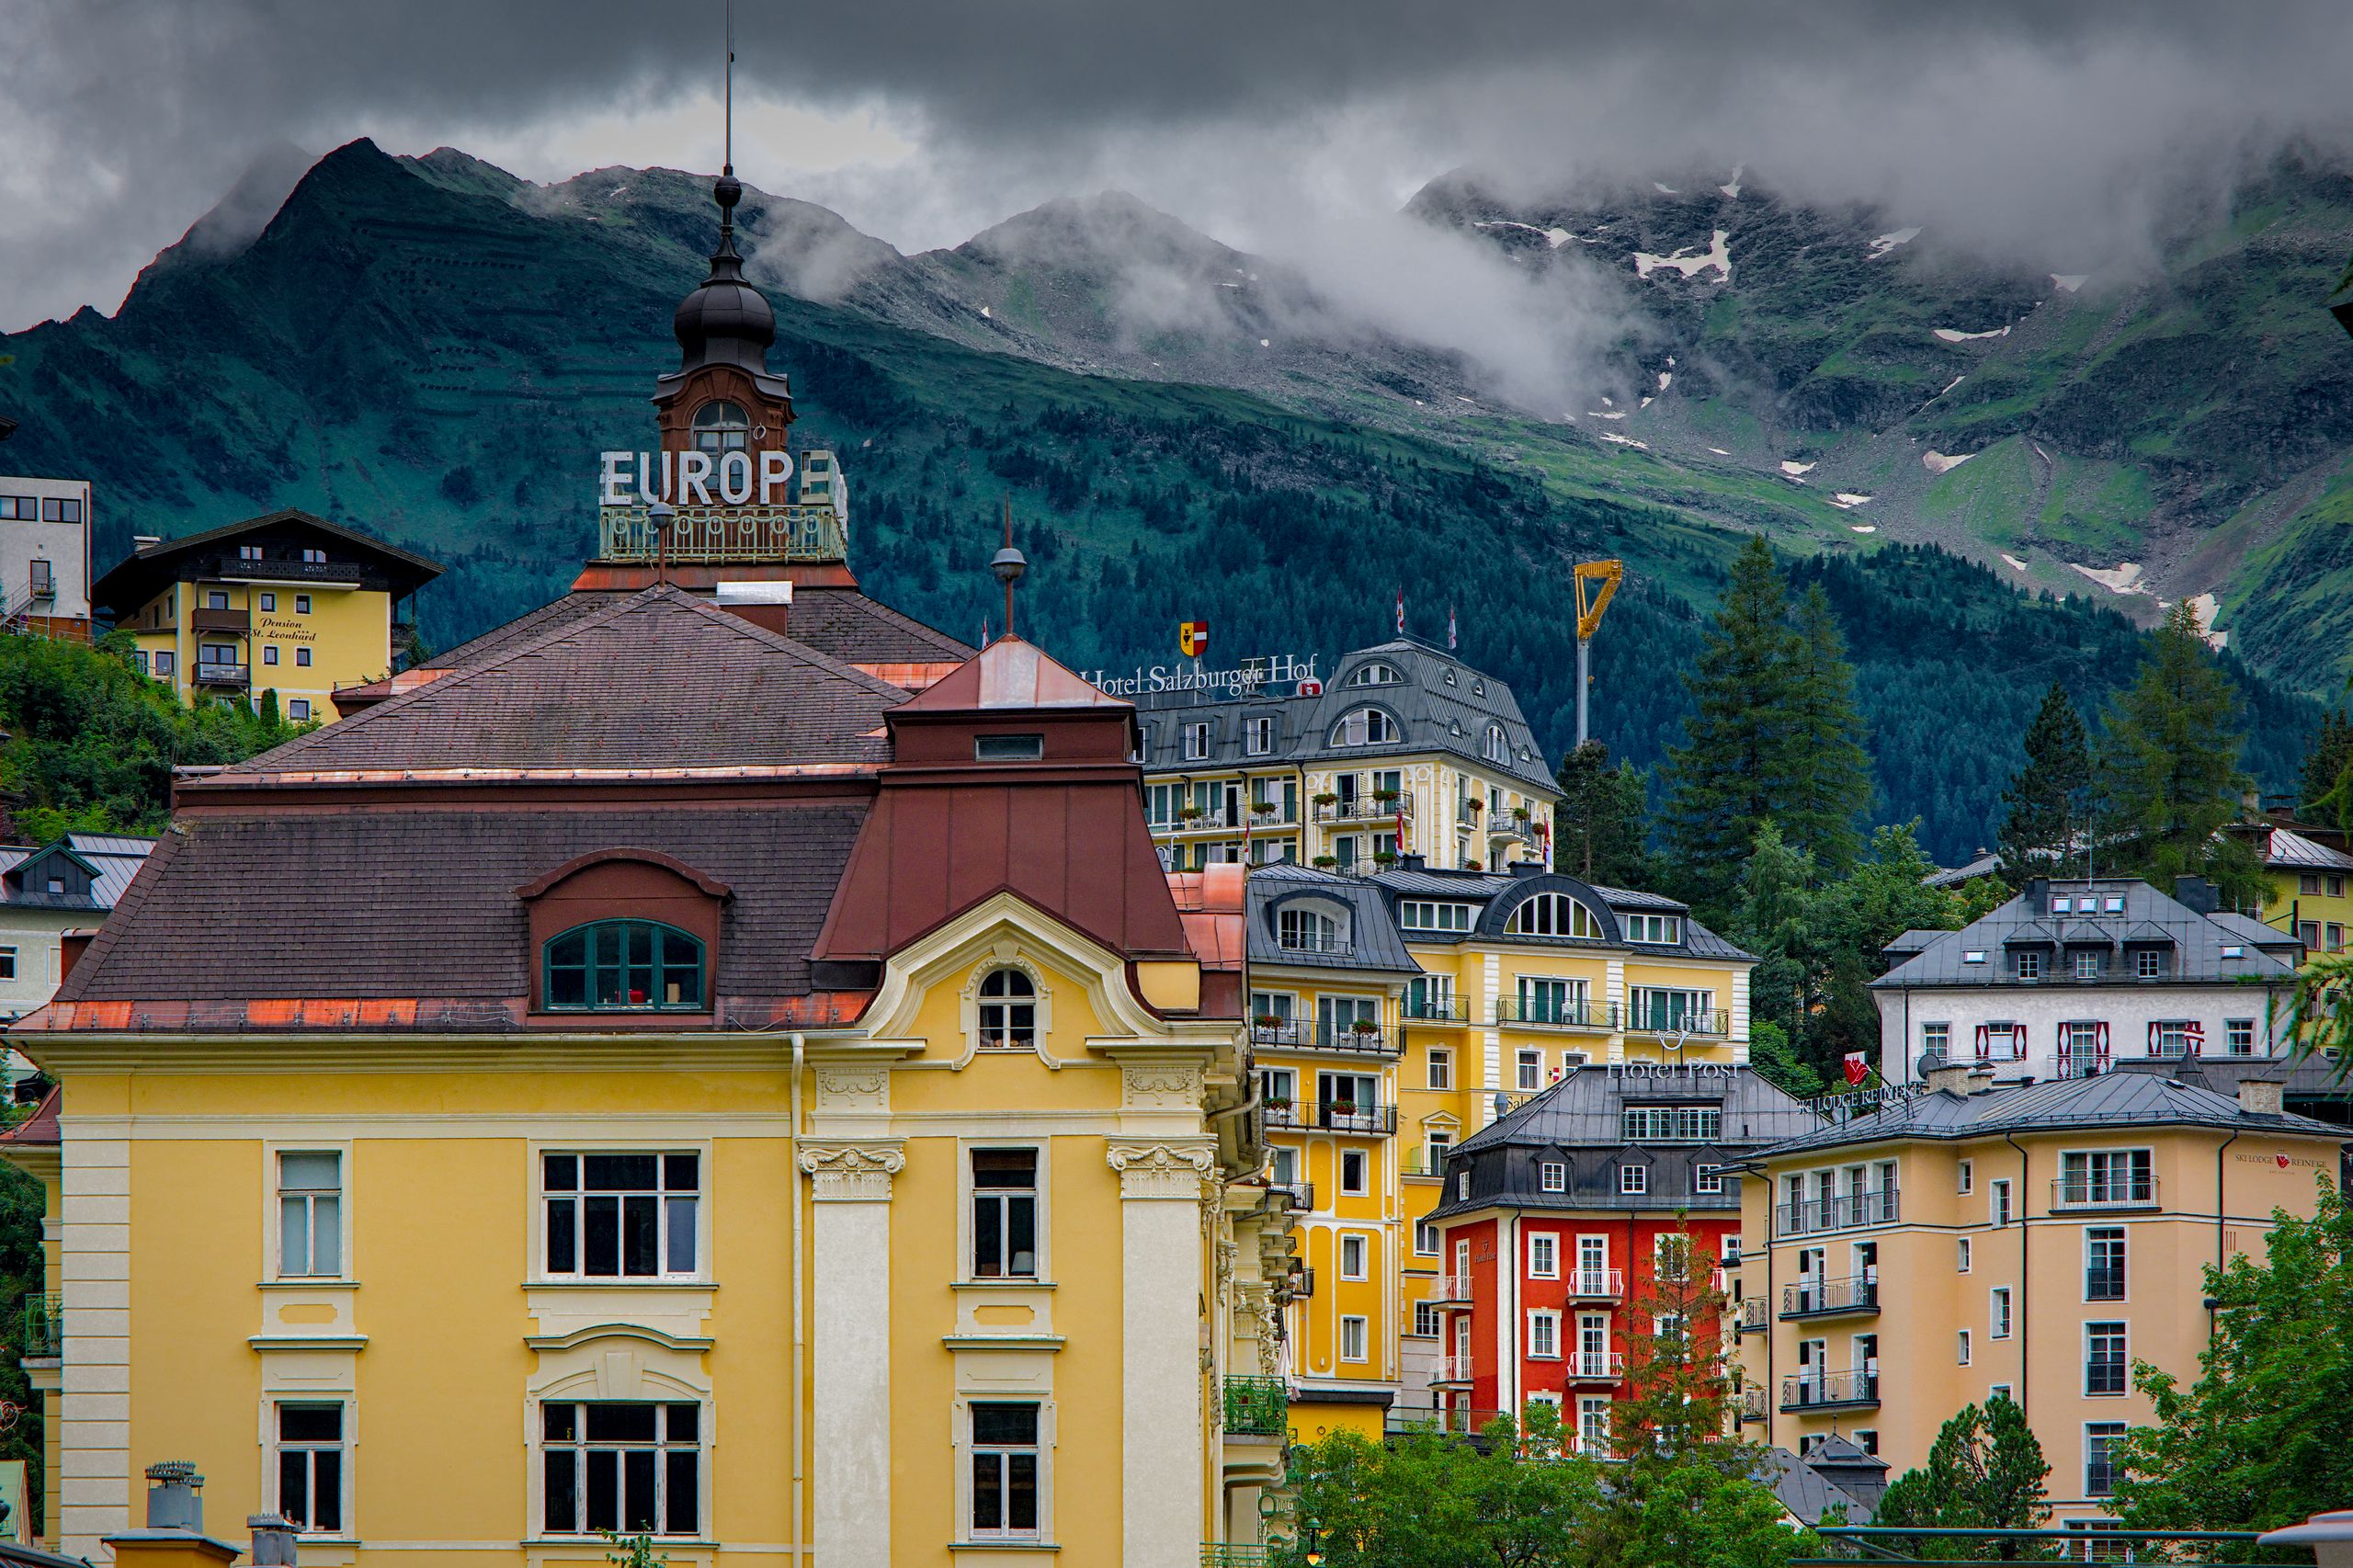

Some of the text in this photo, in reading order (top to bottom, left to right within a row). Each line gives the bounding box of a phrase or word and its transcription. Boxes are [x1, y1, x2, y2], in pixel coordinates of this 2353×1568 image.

[600, 450, 834, 506] EUROPE
[260, 618, 302, 629] Pension
[251, 629, 317, 642] St. Leonhard
[1080, 653, 1318, 697] Hotel Salzburger Hof
[1155, 835, 1180, 863] of
[1606, 1057, 1742, 1079] Hotel Post
[1506, 1096, 1533, 1109] Sal
[1796, 1082, 1924, 1114] SKI LODGE REINEKE
[2248, 1155, 2274, 1165] LODGE
